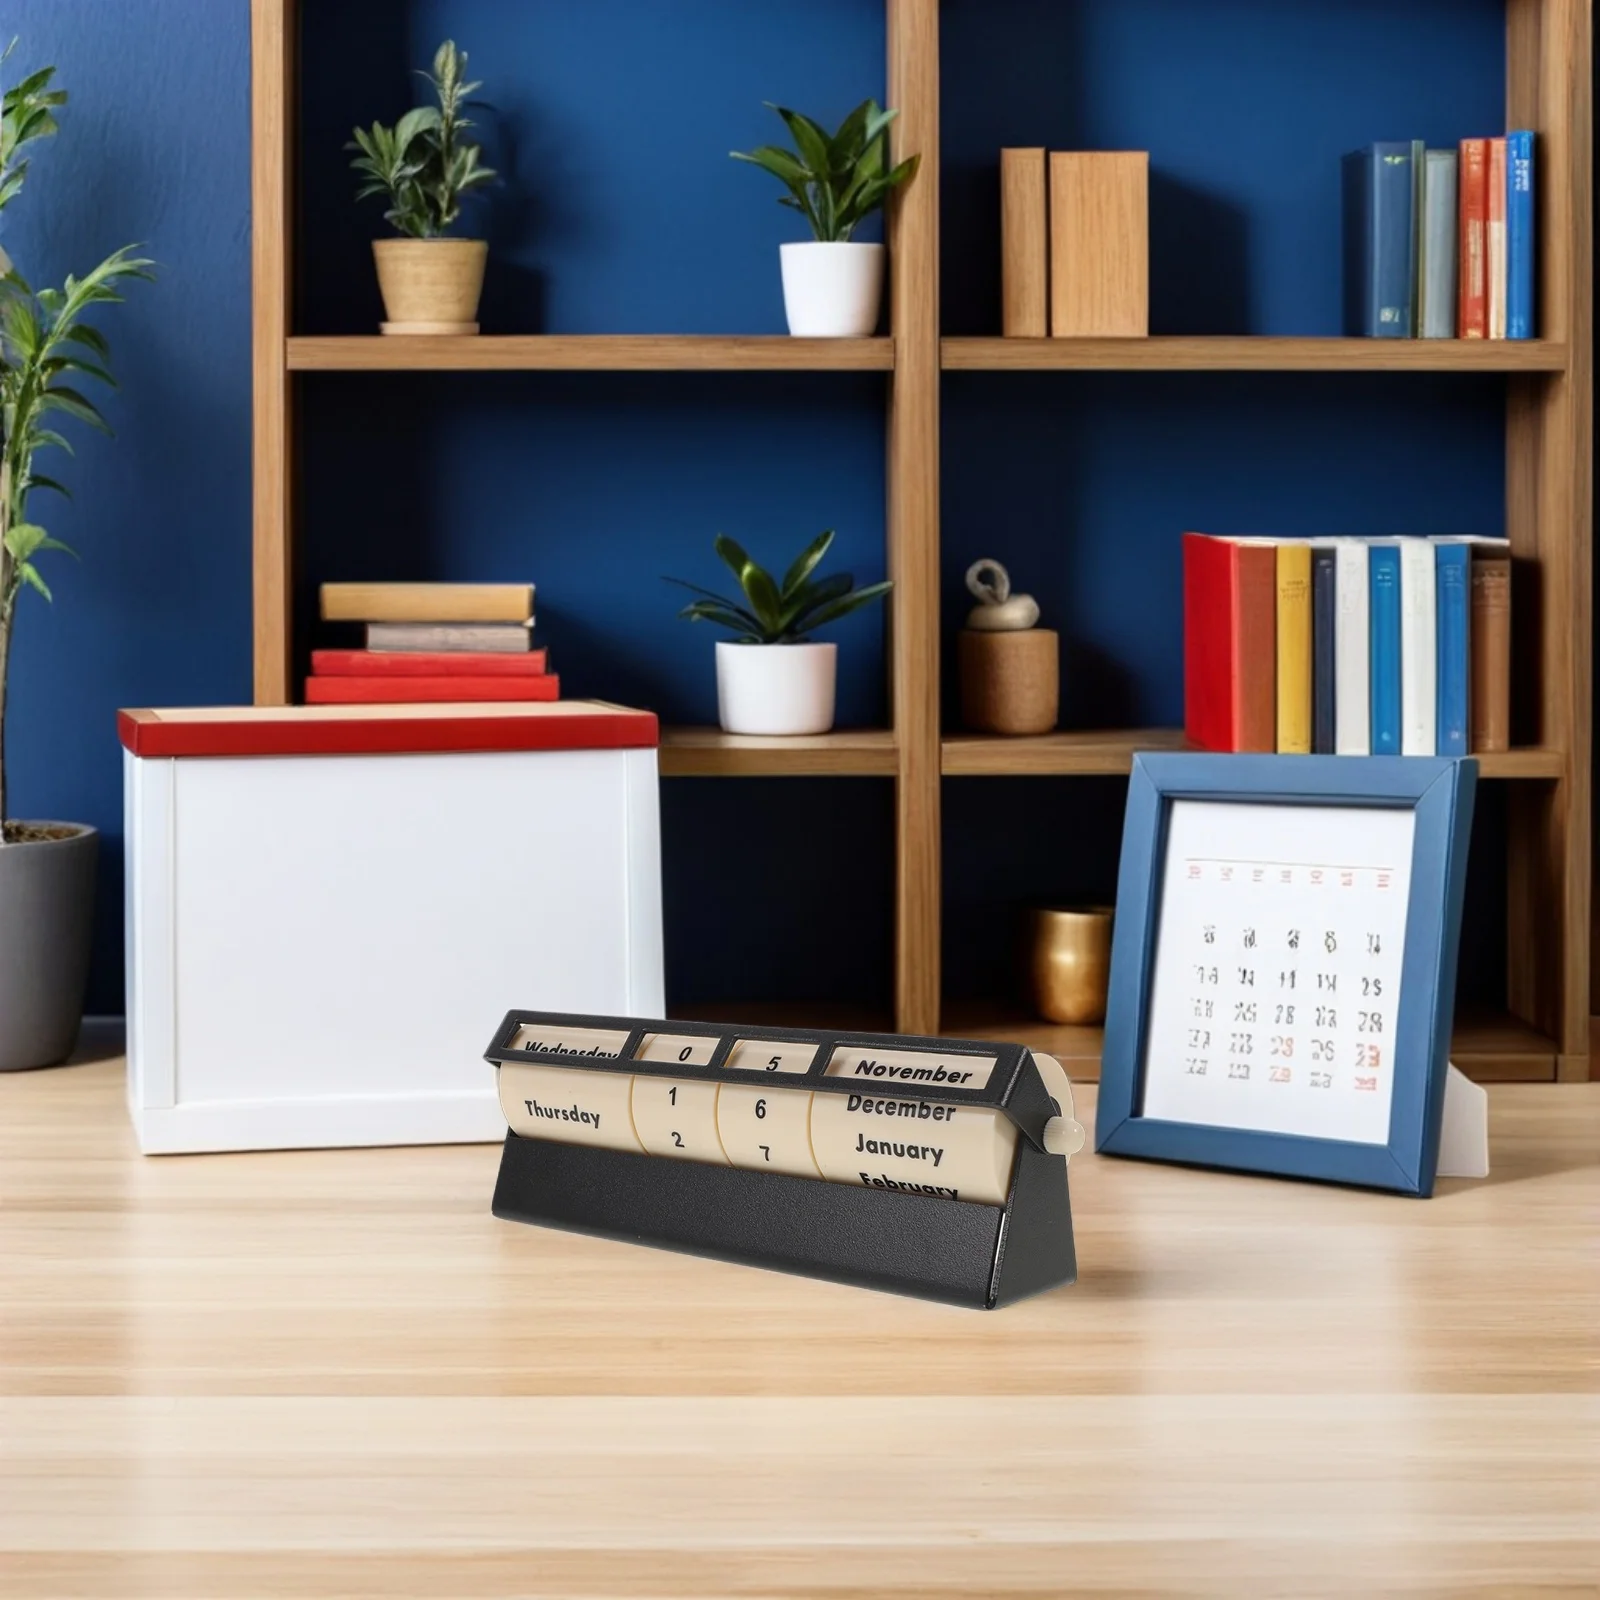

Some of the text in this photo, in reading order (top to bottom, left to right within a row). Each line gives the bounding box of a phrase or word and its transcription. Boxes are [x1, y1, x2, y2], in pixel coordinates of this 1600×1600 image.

[677, 1044, 694, 1062] 0
[764, 1055, 783, 1073] 5
[854, 1059, 974, 1085] November
[667, 1086, 678, 1106] 1
[754, 1098, 767, 1119] 6
[846, 1094, 957, 1122] December
[524, 1099, 602, 1130] Thursday
[670, 1131, 686, 1148] 2
[758, 1145, 771, 1162] 7
[855, 1133, 944, 1167] January
[858, 1171, 959, 1201] February
